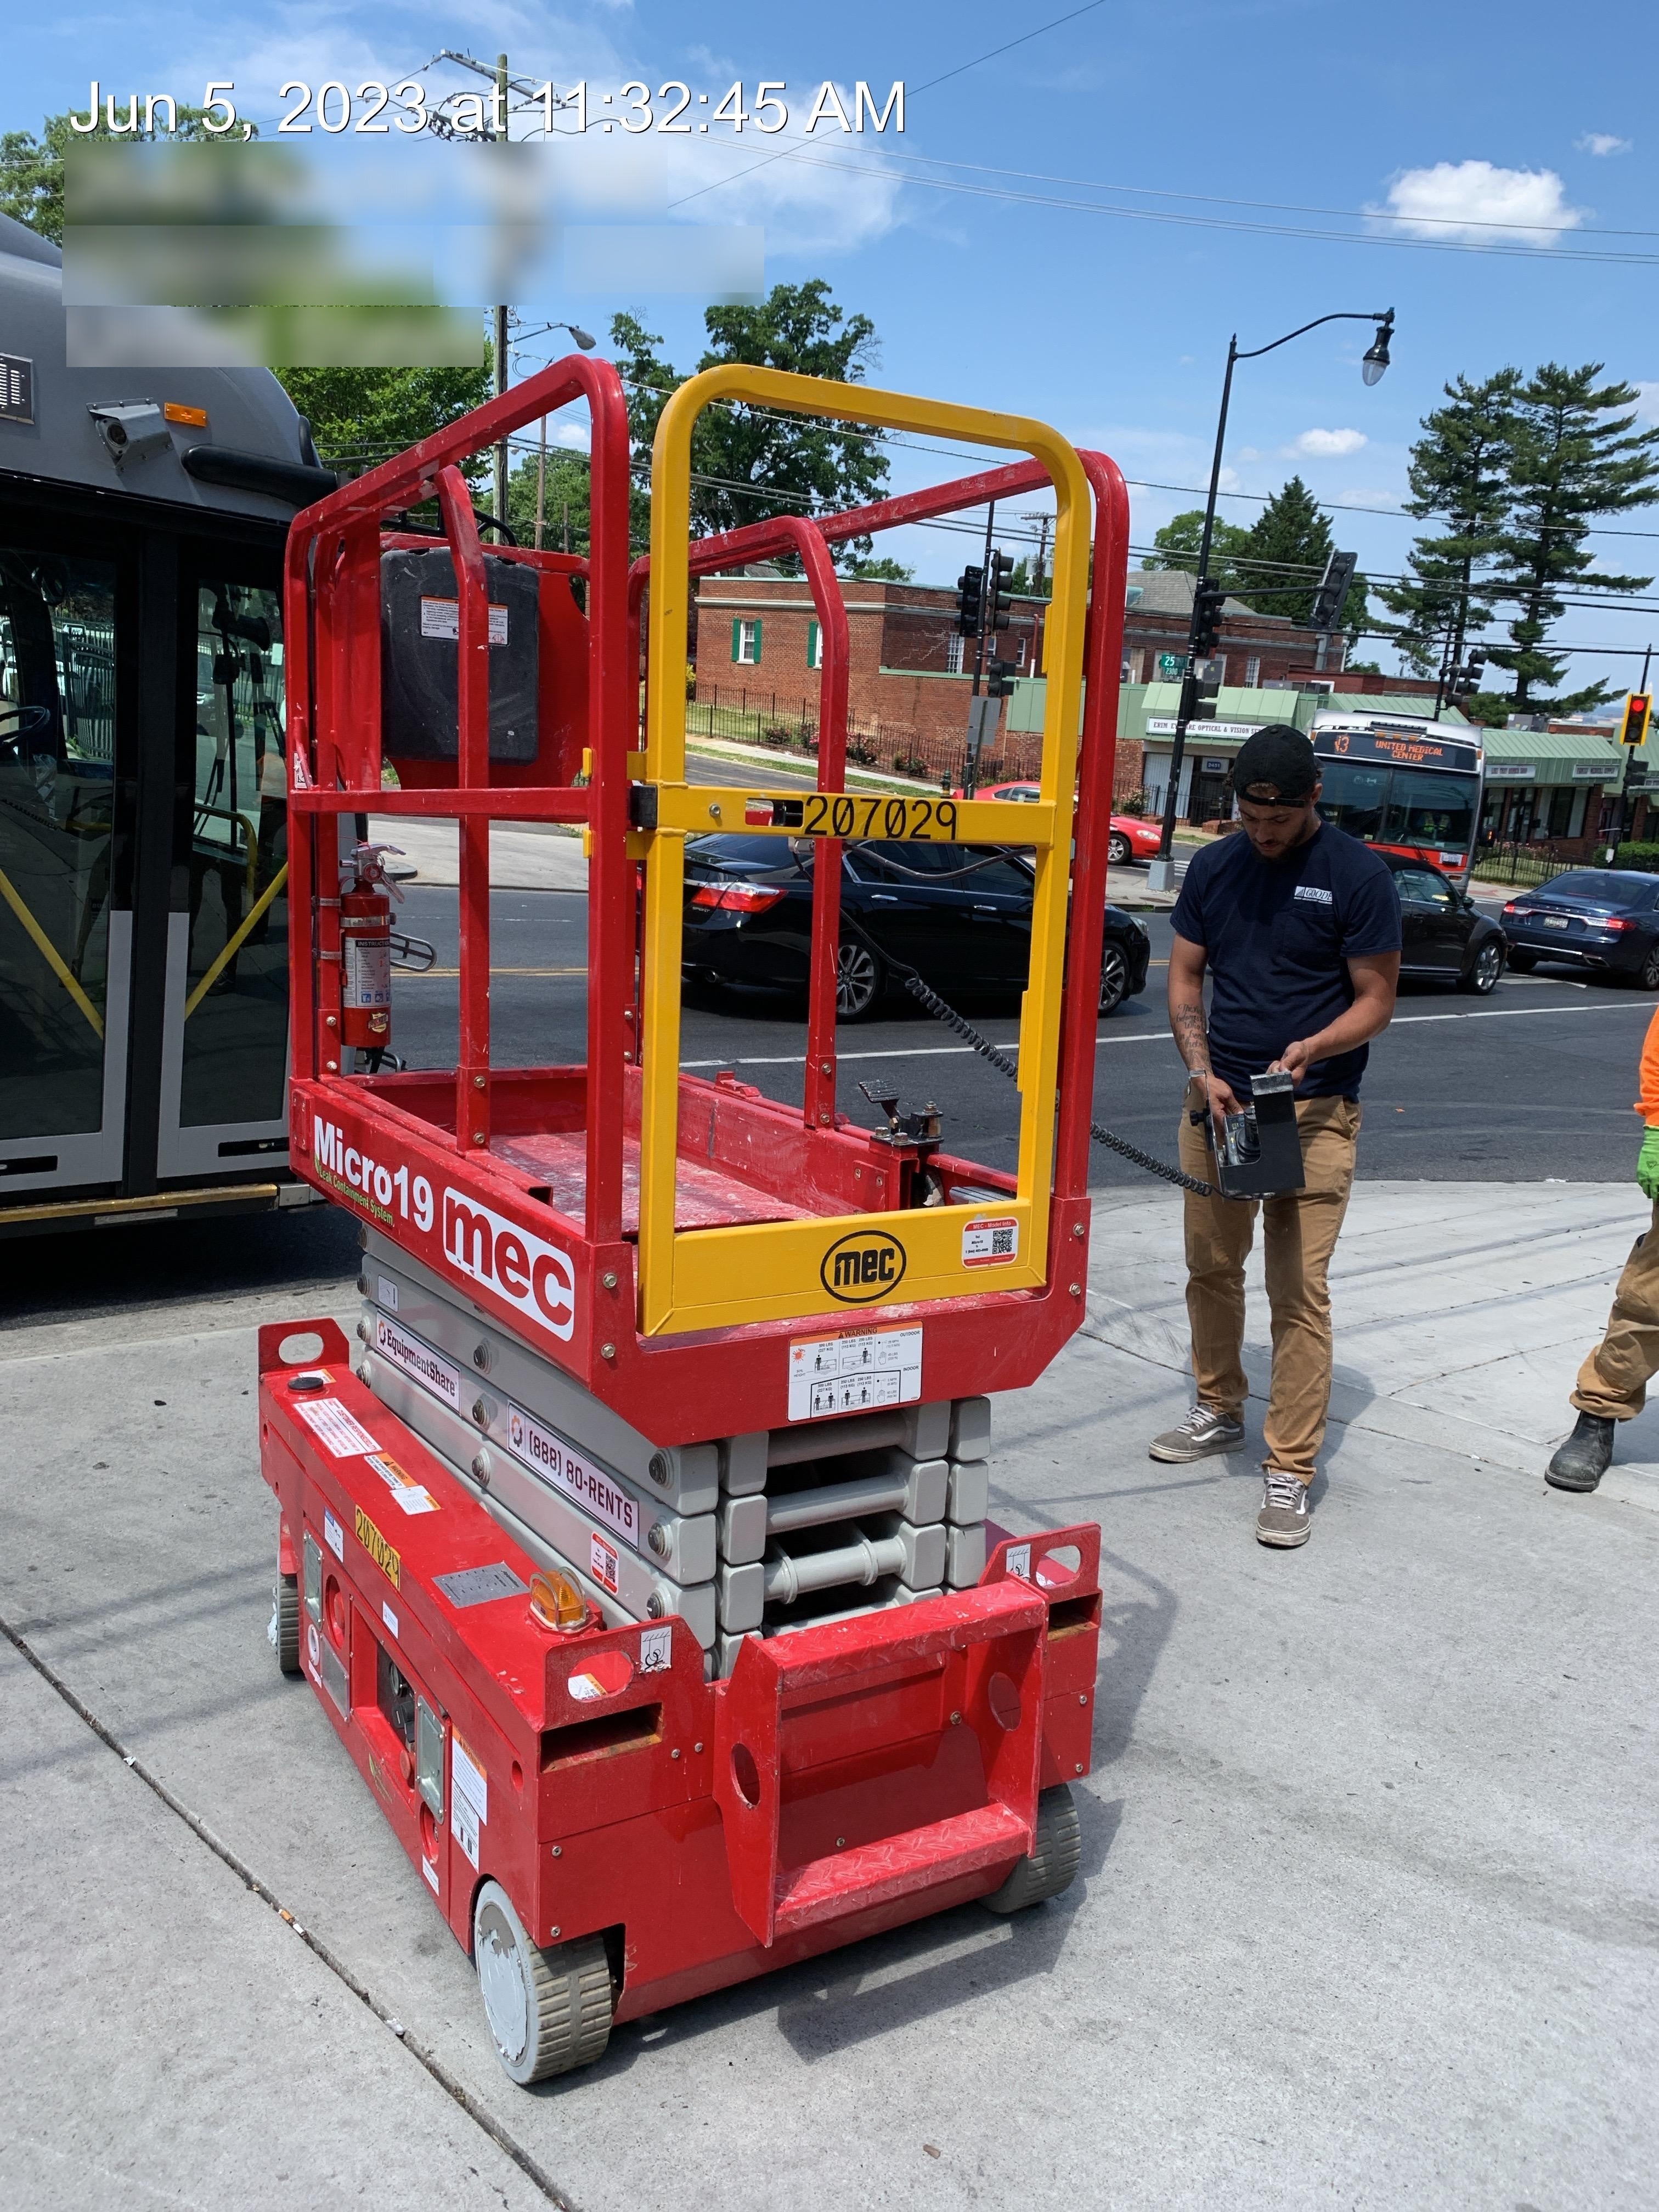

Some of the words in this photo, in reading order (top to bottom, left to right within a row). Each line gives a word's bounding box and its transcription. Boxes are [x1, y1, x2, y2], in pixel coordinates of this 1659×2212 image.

[1164, 656, 1175, 667] 25
[1375, 740, 1406, 751] UNITED
[1408, 744, 1443, 756] MEDICAL
[1391, 750, 1424, 761] CENTER
[804, 795, 957, 840] 207029
[314, 1115, 435, 1232] Micro19
[320, 1166, 332, 1184] Leak
[334, 1175, 369, 1210] Containment
[845, 1328, 878, 1338] WARNING
[387, 1328, 455, 1397] EquipmentShare
[391, 1465, 408, 1480] WARNING
[529, 1430, 562, 1476] (888)
[566, 1458, 633, 1528] 80-RENTS
[357, 1509, 399, 1589] 207029
